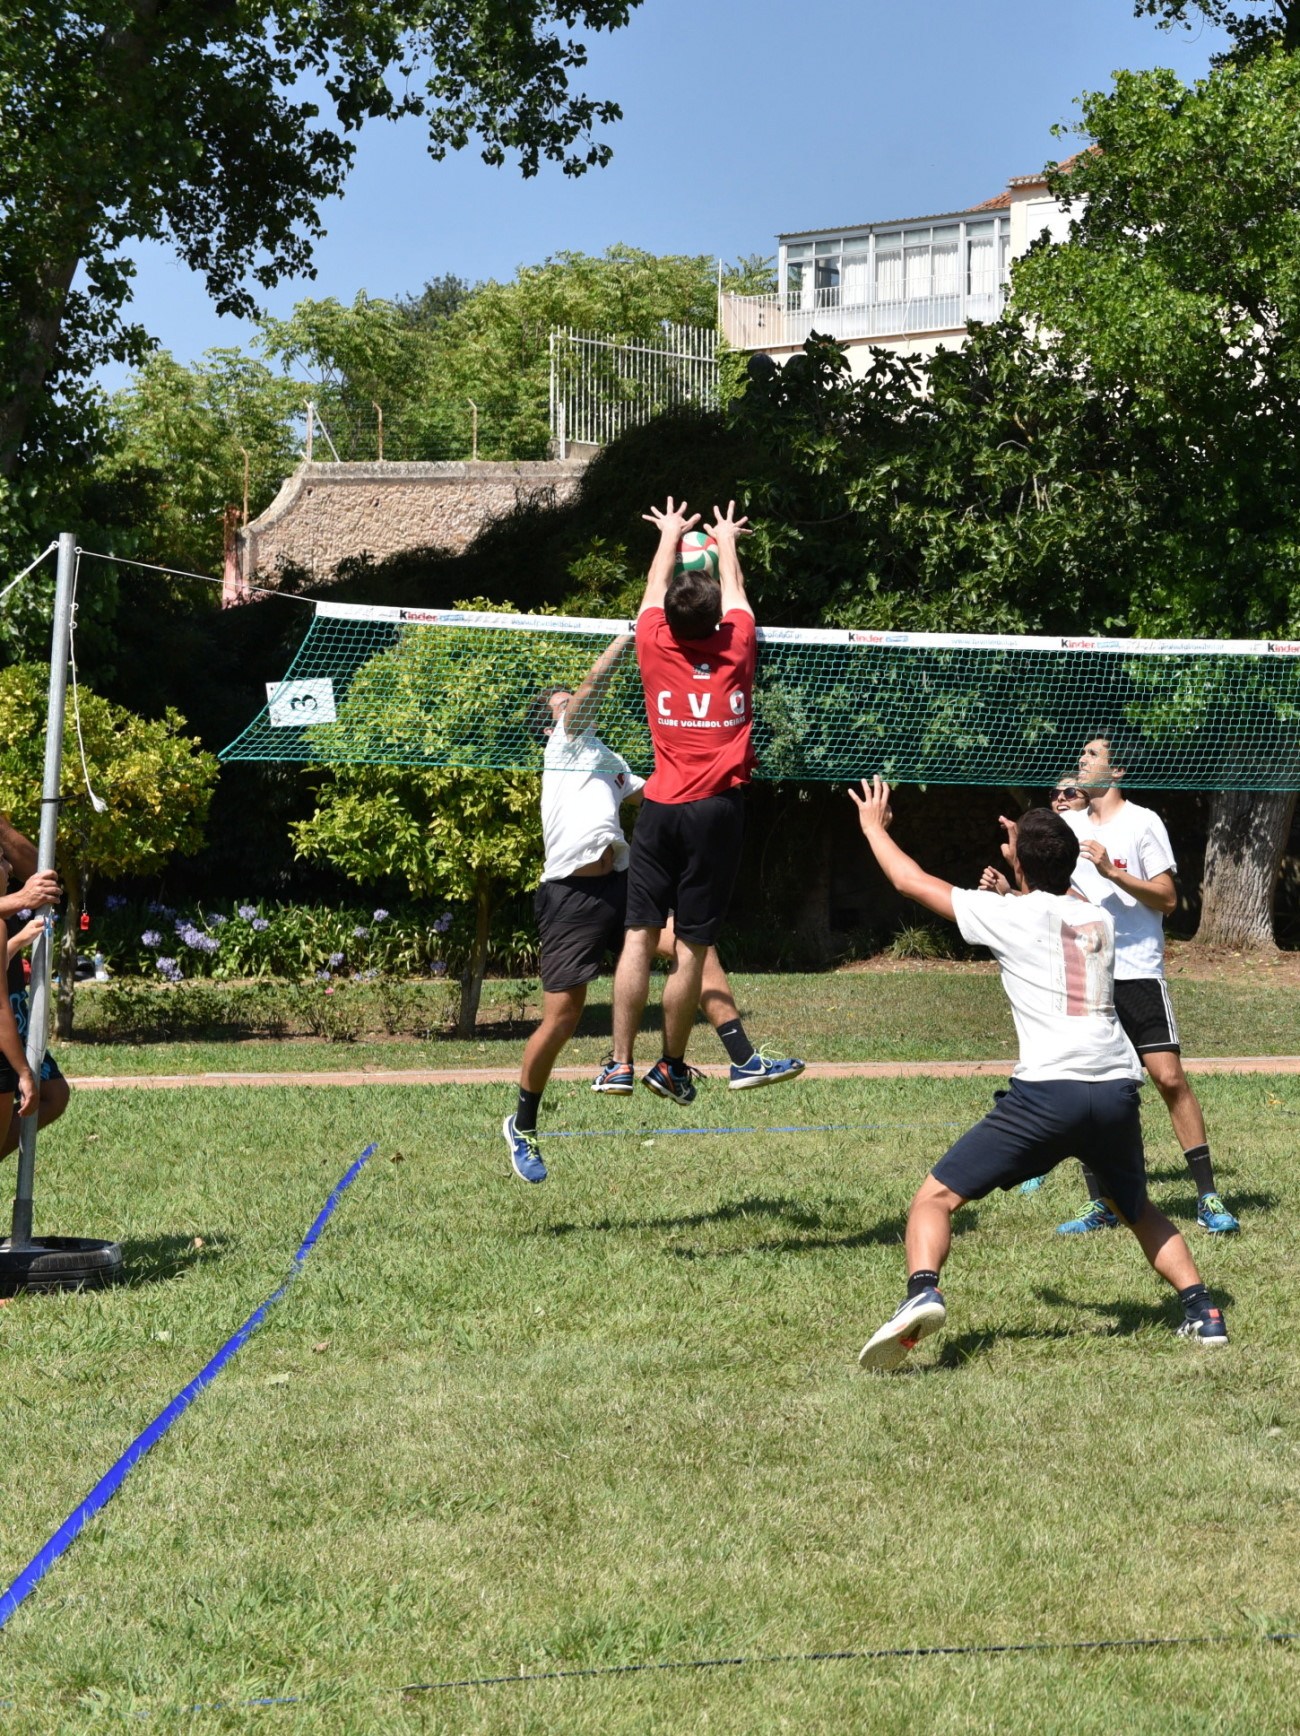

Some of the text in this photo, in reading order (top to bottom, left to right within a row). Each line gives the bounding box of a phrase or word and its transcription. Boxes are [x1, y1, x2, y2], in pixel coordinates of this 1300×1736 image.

[290, 694, 318, 711] 3
[658, 717, 679, 727] CLUBE
[681, 720, 722, 728] VOLEIBOL
